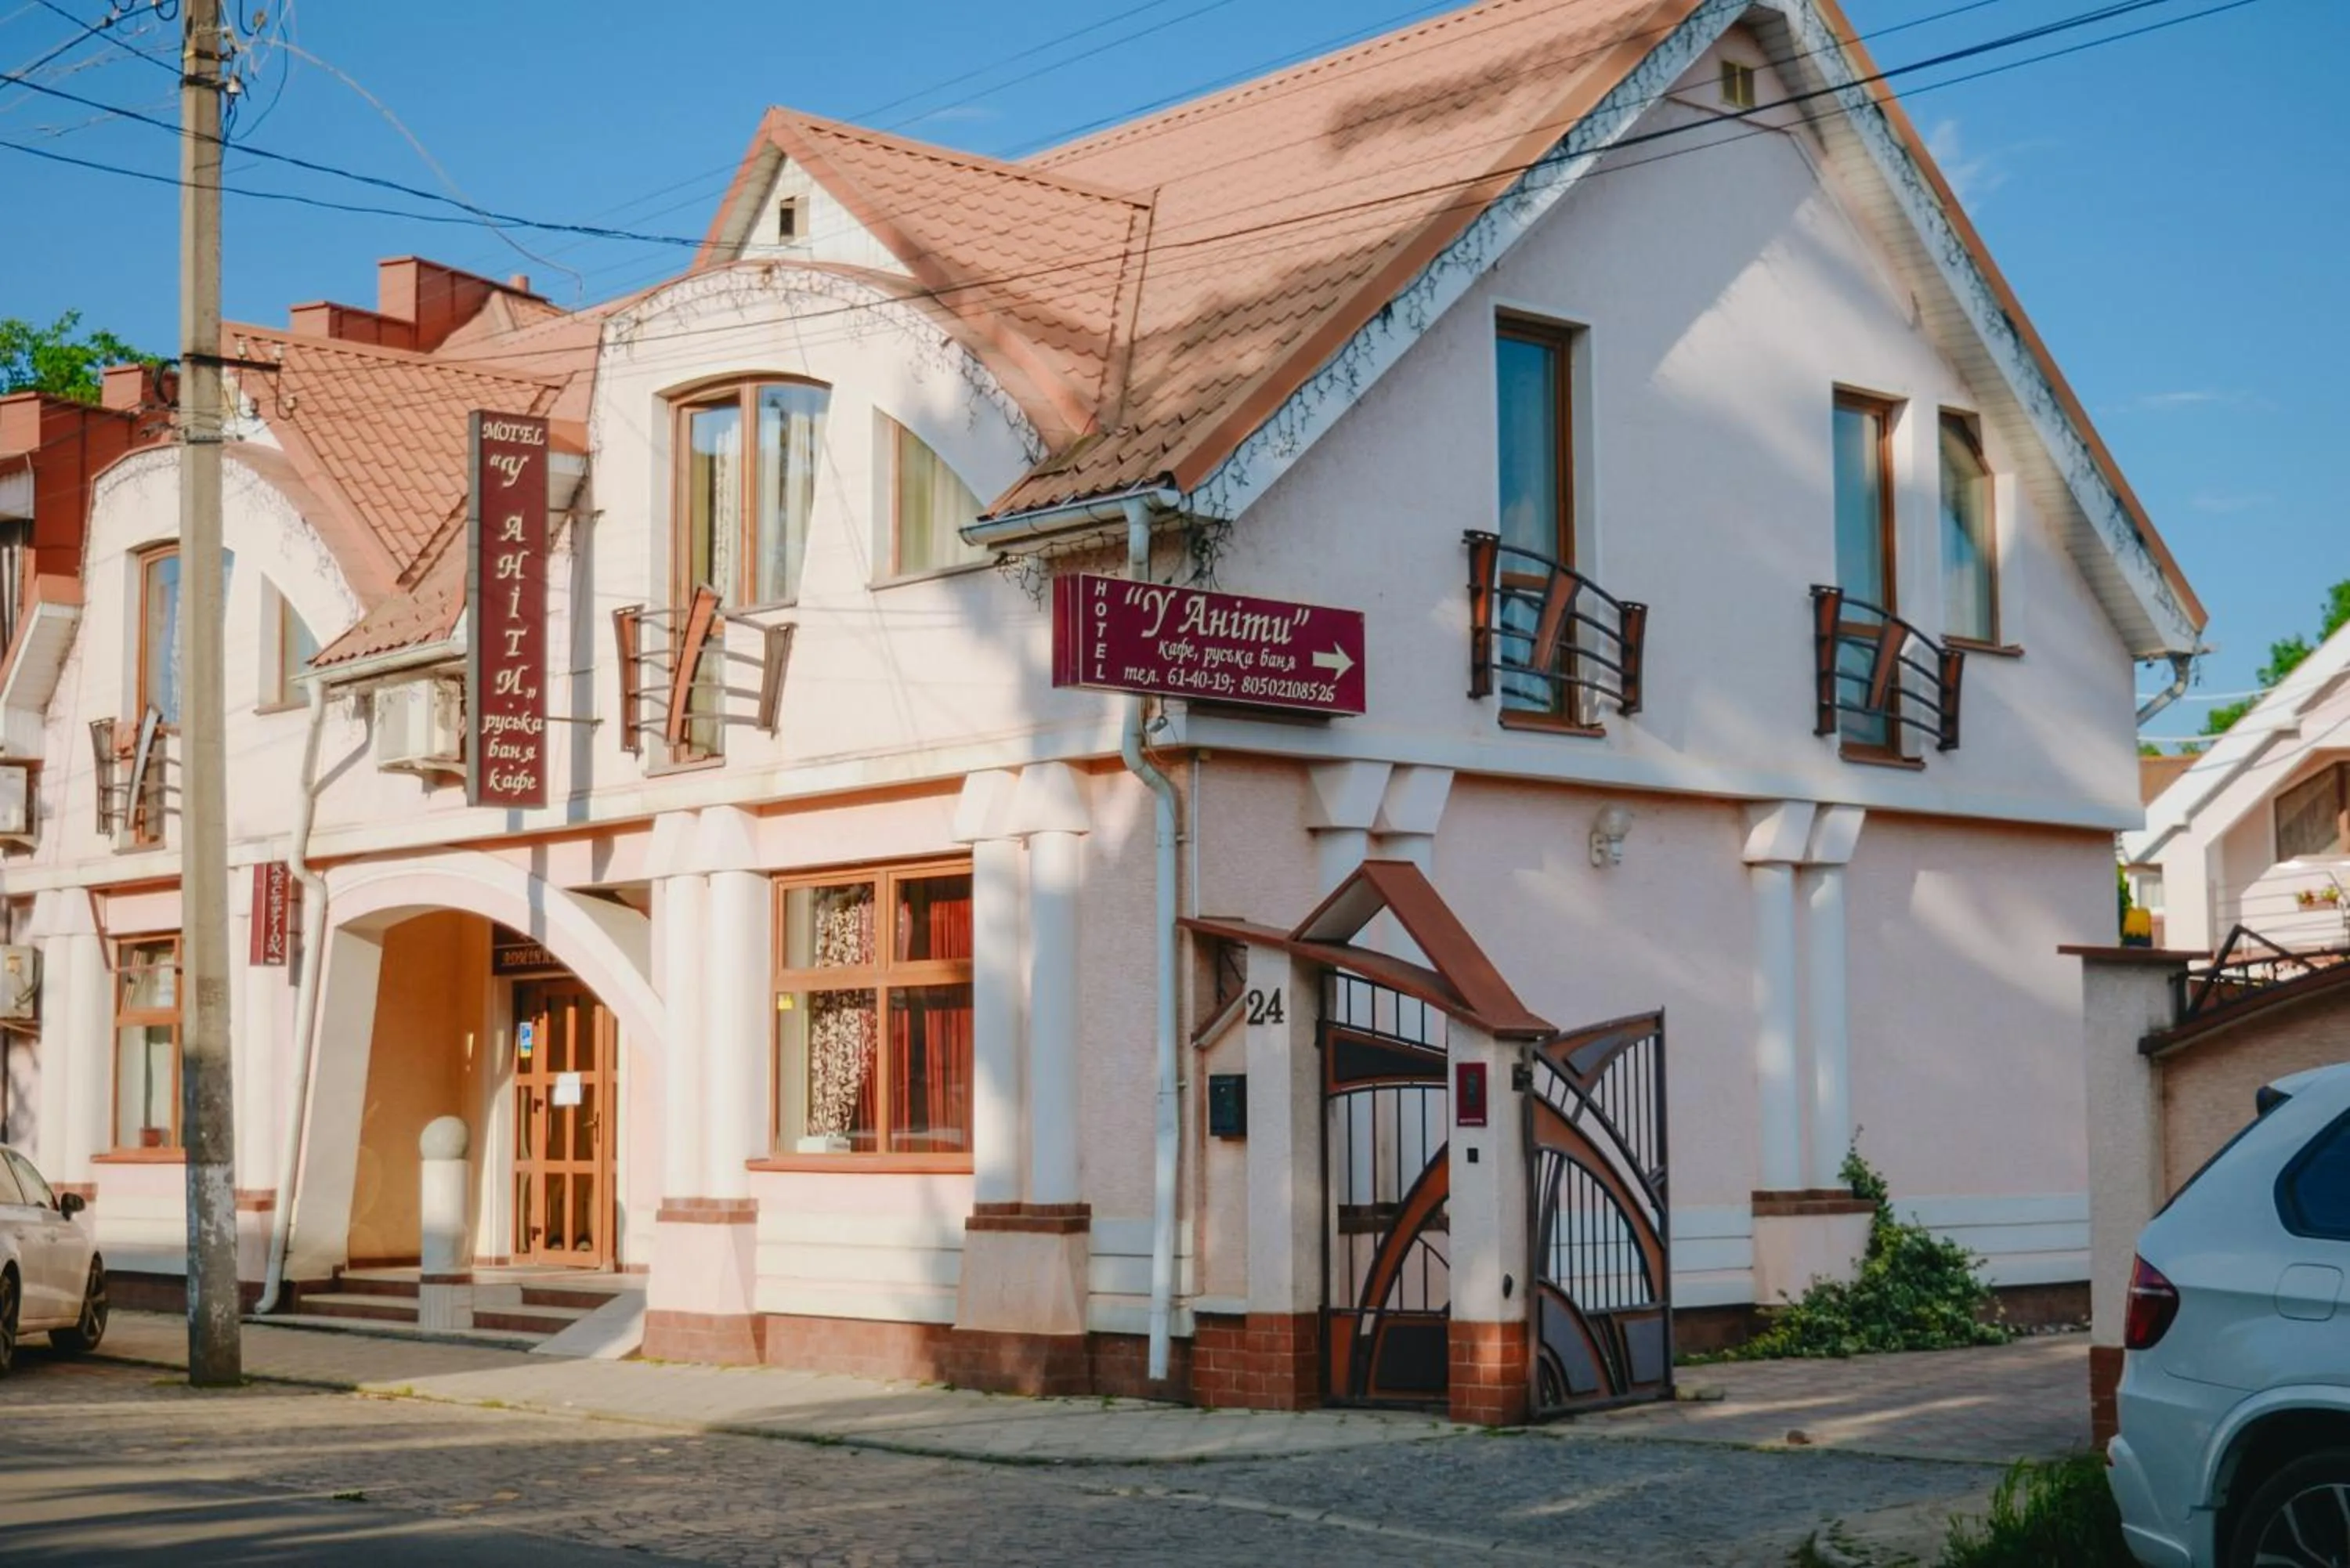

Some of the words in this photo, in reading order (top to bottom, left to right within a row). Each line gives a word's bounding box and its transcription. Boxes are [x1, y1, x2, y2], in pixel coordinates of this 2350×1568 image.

[1094, 580, 1107, 680] HOTEL
[1201, 646, 1254, 671] руська
[1259, 649, 1297, 672] баня
[1123, 666, 1160, 685] тел.
[1241, 678, 1336, 703] 80502108526
[481, 710, 544, 735] руська
[487, 737, 538, 762] баня
[1247, 988, 1284, 1025] 24
